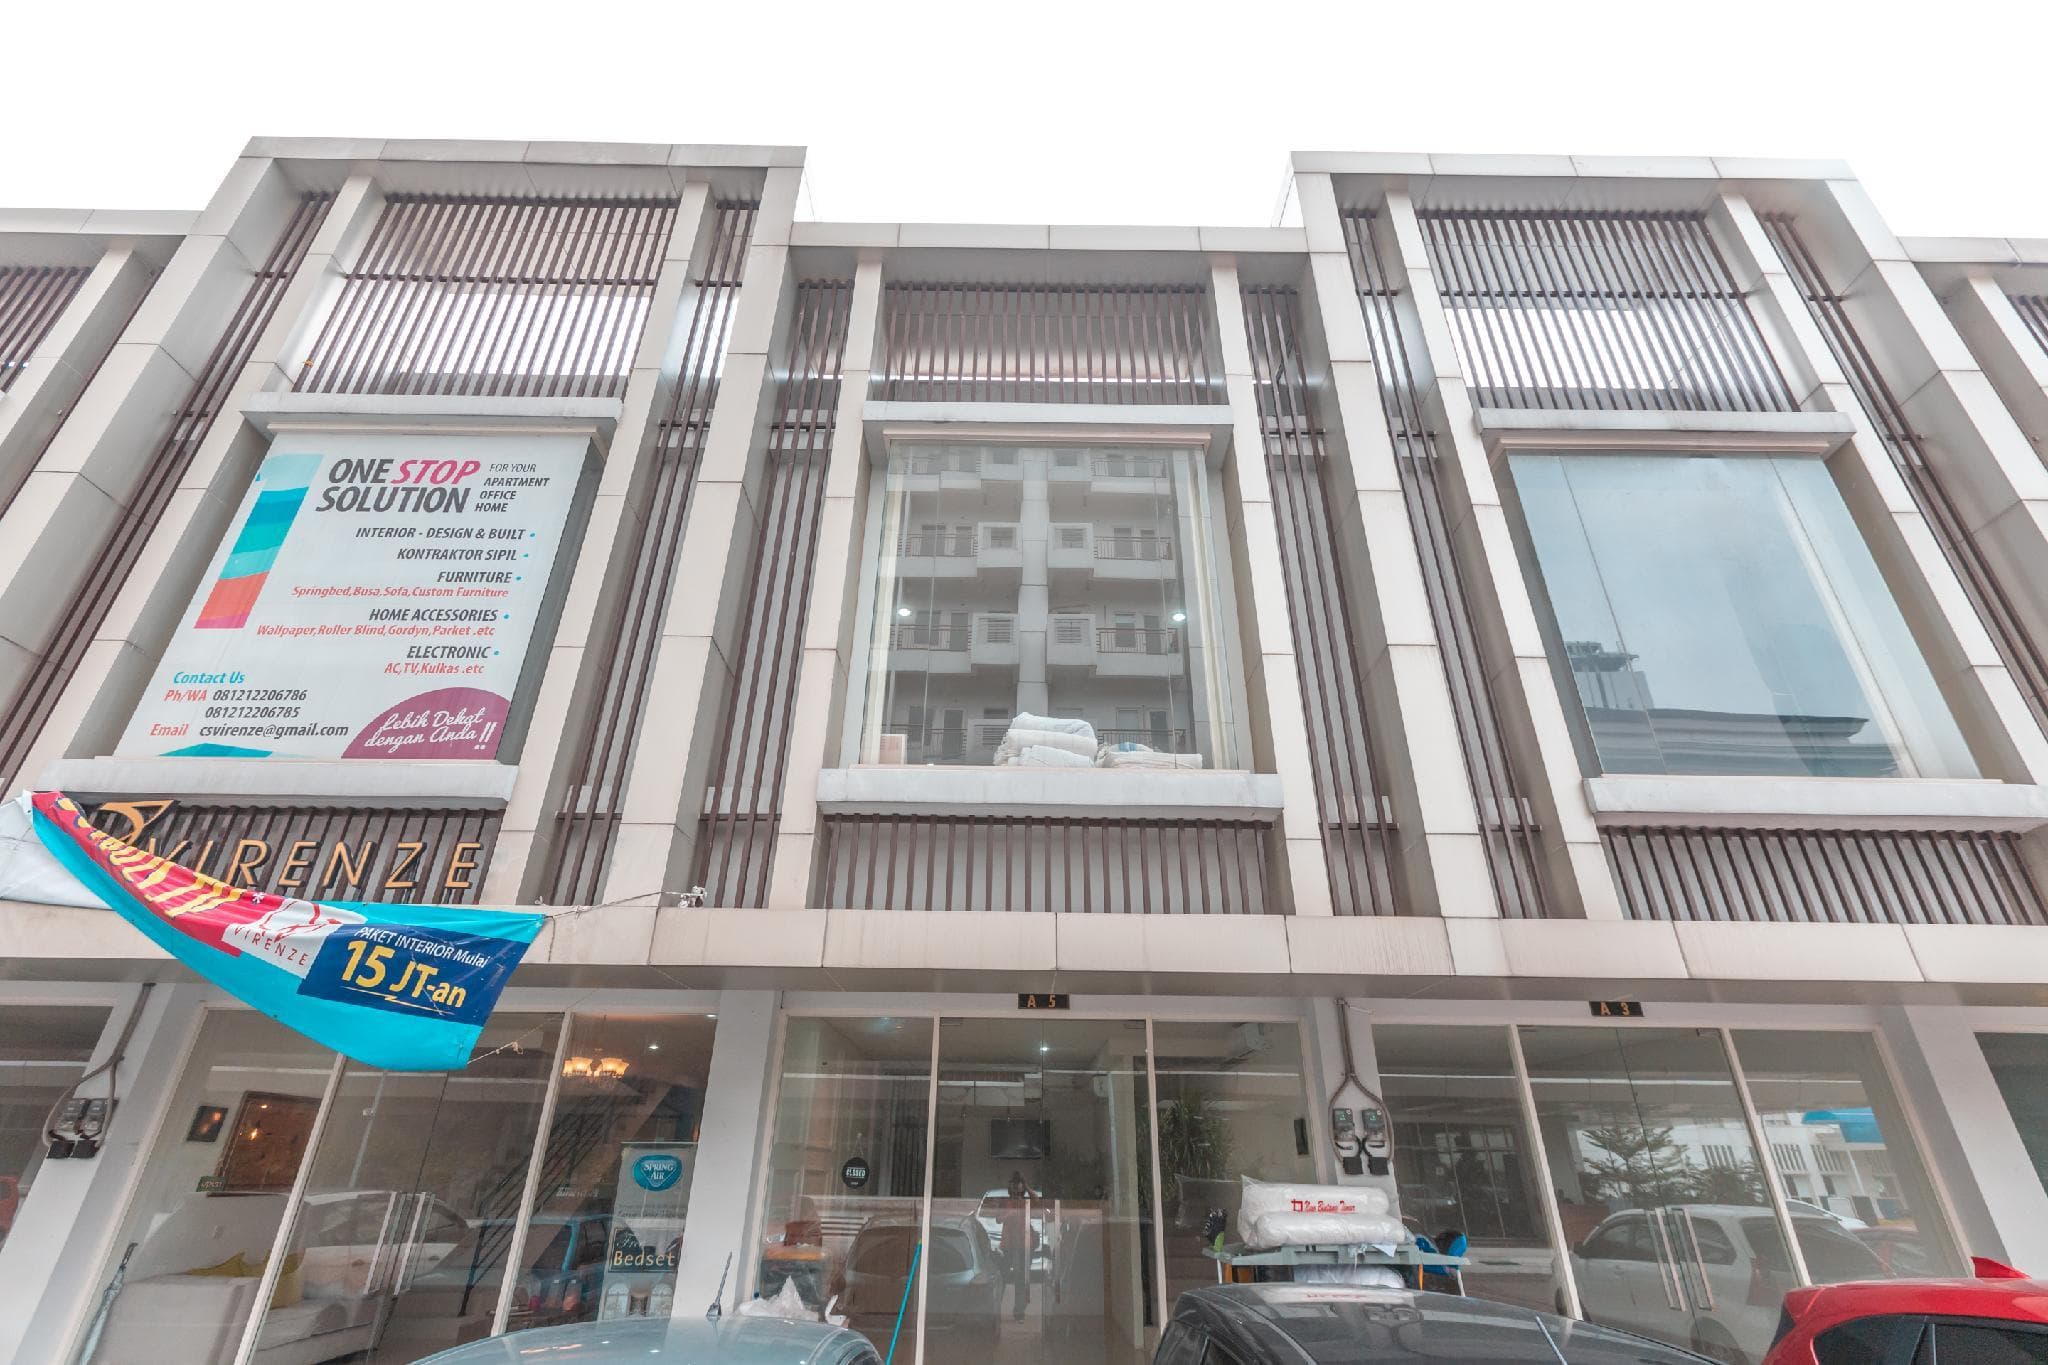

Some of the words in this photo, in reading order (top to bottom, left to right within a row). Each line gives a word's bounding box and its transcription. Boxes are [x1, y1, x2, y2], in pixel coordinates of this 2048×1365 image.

[329, 459, 394, 484] ONE
[391, 460, 481, 485] STOP
[490, 463, 508, 473] FOR
[511, 463, 536, 473] YOUR
[483, 477, 550, 487] APARTMENT
[315, 486, 471, 513] SOLUTION
[479, 490, 516, 500] OFFICE
[475, 503, 508, 513] HOME
[355, 527, 417, 538] INTERIOR
[426, 528, 474, 539] DESIGN
[475, 528, 485, 539] &
[488, 528, 527, 540] BUILT
[397, 548, 483, 561] KONTRAKTOR
[485, 549, 518, 561] SIPIL
[437, 571, 512, 583] FURNITURE
[456, 586, 509, 598] Furniture
[369, 609, 410, 621] HOME
[411, 609, 498, 622] ACCESSORIES
[473, 627, 495, 636] .etc
[407, 646, 492, 659] ELECTRONIC
[462, 664, 484, 674] .etc
[173, 671, 226, 684] Contact
[229, 671, 245, 684] Us
[164, 689, 207, 702] Ph/WA
[212, 689, 308, 701] 081212206786
[205, 707, 301, 718] 081212206785
[380, 710, 430, 731] Lebih
[432, 707, 486, 728] Dekat
[150, 723, 189, 736] Email
[199, 723, 349, 739] csvirenze@gmail.com
[364, 730, 425, 754] dengan
[234, 926, 309, 966] VIRENZE
[354, 926, 398, 947] PAKET
[396, 935, 454, 959] INTERIOR
[454, 948, 491, 968] Mulai
[341, 940, 396, 988] 15
[390, 960, 466, 1008] JT-an
[1027, 994, 1037, 1008] A
[1048, 994, 1056, 1008] 5
[1600, 1001, 1611, 1015] A
[1620, 1001, 1630, 1015] 3
[643, 1162, 674, 1172] SPRING
[613, 1250, 675, 1266] Bedset
